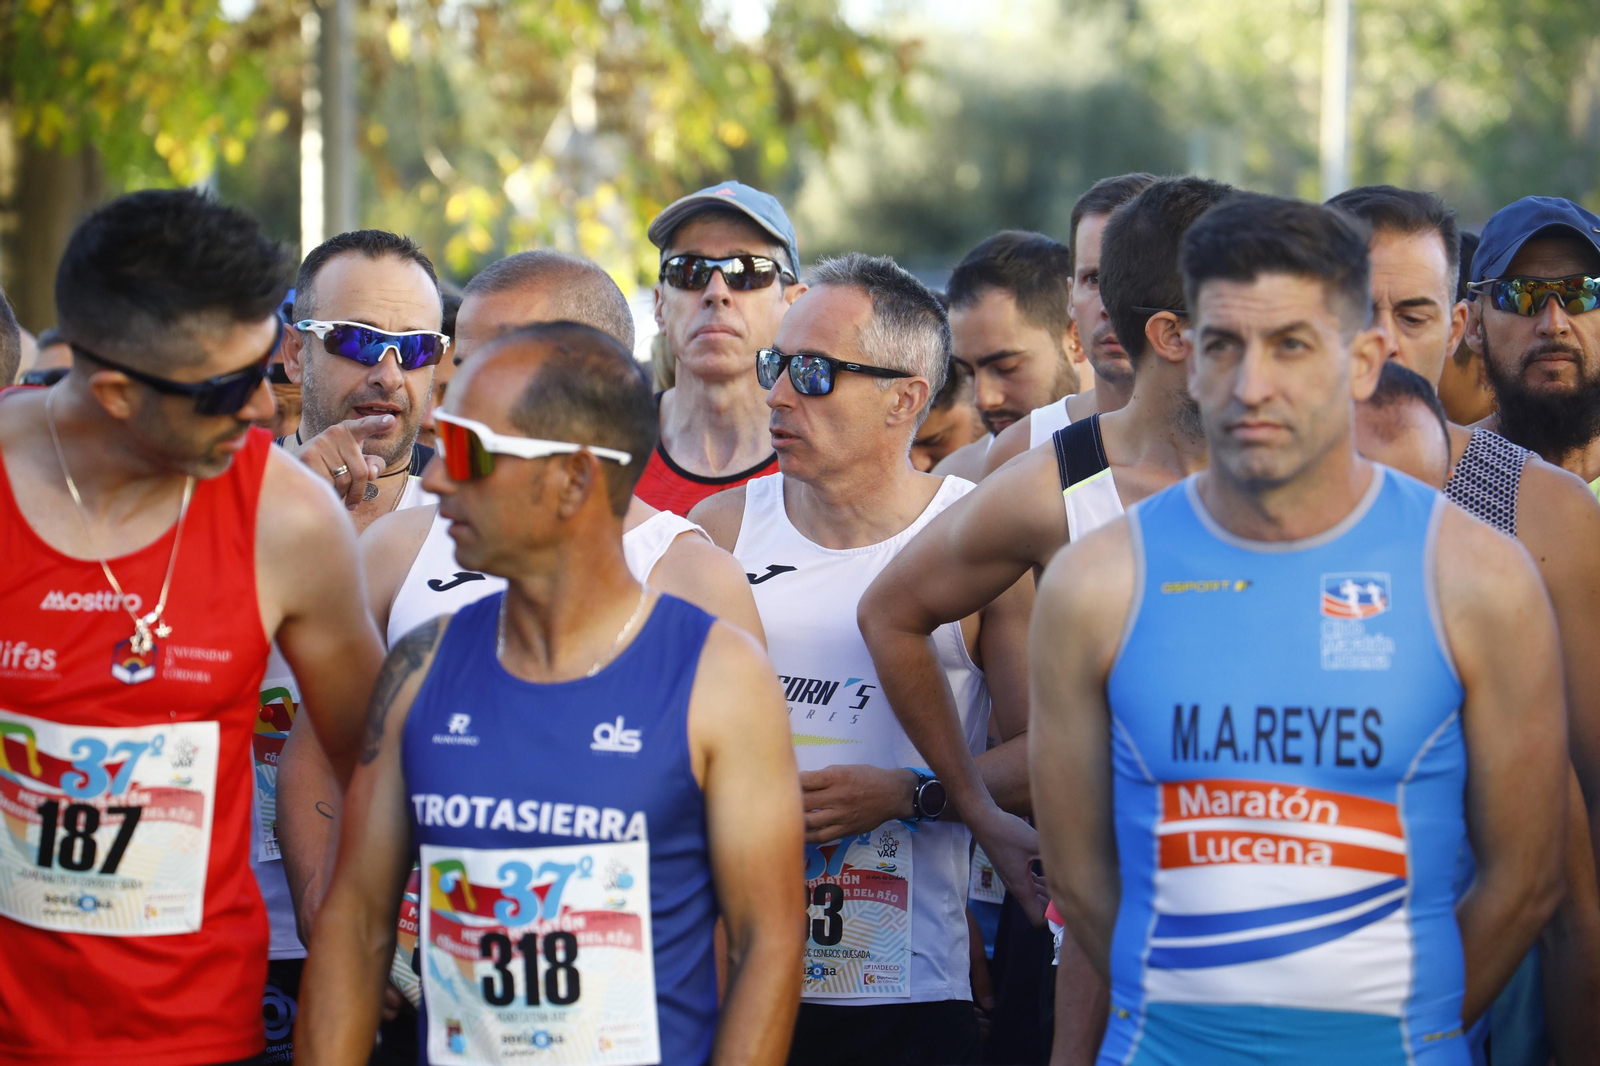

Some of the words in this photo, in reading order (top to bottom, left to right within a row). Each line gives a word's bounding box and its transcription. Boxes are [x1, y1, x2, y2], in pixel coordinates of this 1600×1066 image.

[1173, 704, 1383, 768] M.A.REYES
[411, 793, 648, 842] TROTASIERRA
[1178, 783, 1340, 825] Maratón
[36, 799, 142, 876] 187
[1187, 832, 1333, 867] Lucena
[805, 872, 860, 889] ARATÓN
[853, 889, 874, 898] DEL
[876, 889, 899, 904] RÍO
[804, 883, 844, 947] 3
[480, 931, 581, 1007] 318
[842, 949, 871, 959] QUESADA
